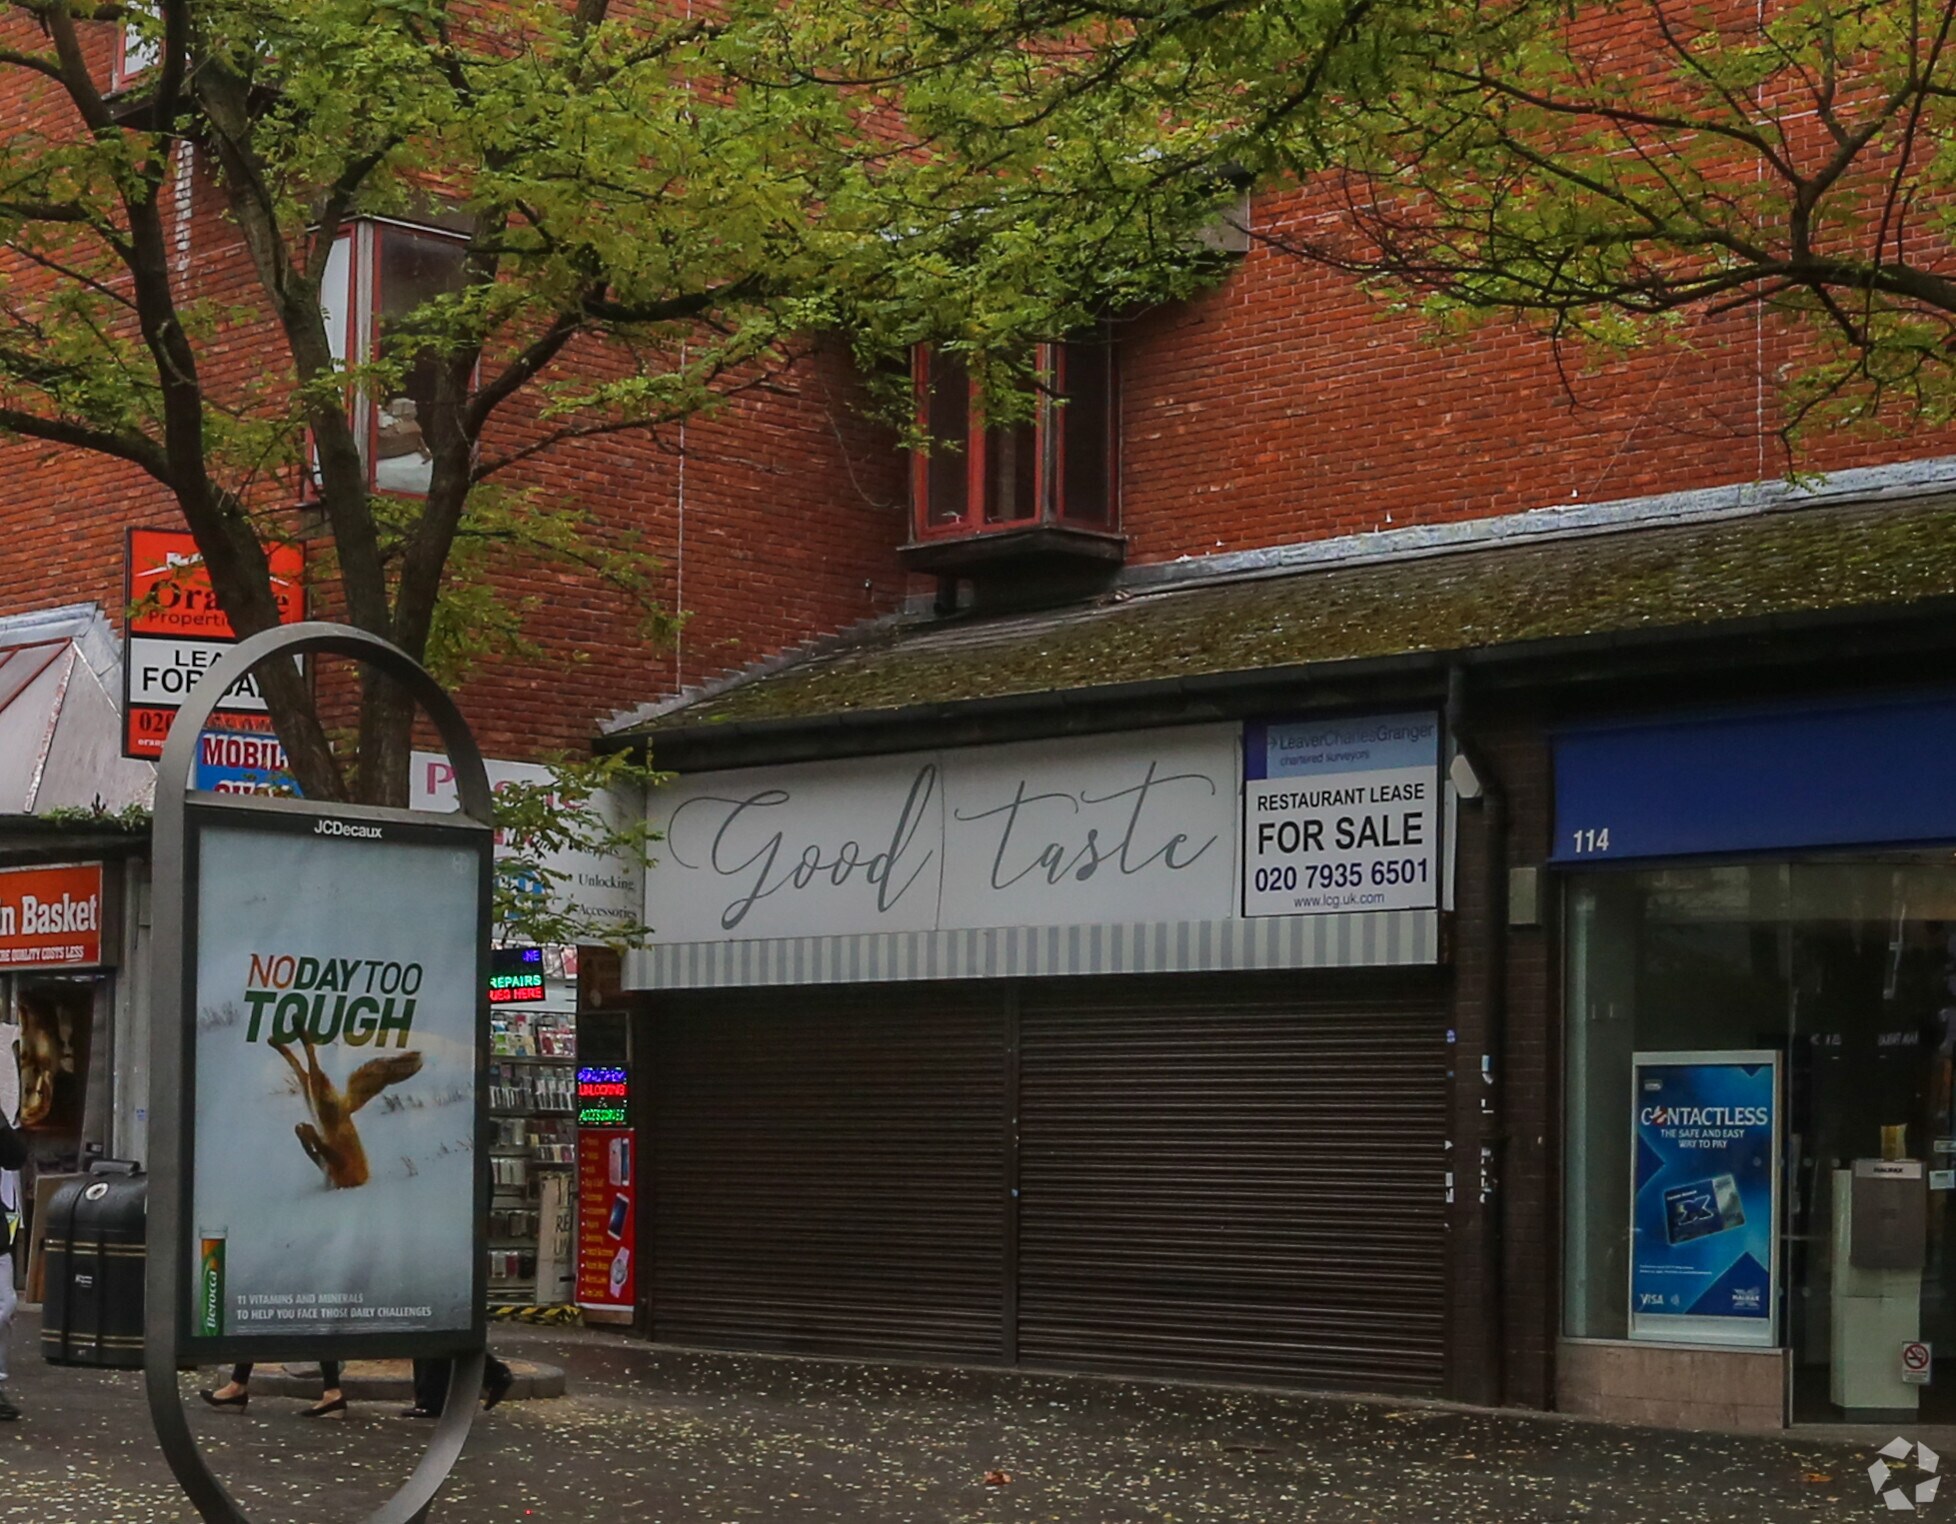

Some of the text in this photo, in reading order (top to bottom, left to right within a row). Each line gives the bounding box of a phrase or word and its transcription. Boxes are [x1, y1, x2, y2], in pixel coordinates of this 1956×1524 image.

[149, 580, 290, 616] Orae
[1280, 752, 1324, 766] chartered
[1258, 783, 1425, 811] RESTAURANT LEASE
[314, 820, 382, 838] JCDecaux
[1258, 812, 1423, 855] FOR SALE
[668, 760, 1219, 930] Good taste
[1573, 828, 1610, 853] 114
[578, 873, 636, 890] Unlocking
[1255, 858, 1427, 892] 020 7935 6501
[1293, 893, 1385, 909] www.lcg.uk.com
[21, 893, 97, 934] Basket
[65, 945, 84, 959] LESS
[247, 953, 423, 996] NO DAY TOO
[243, 990, 416, 1048] TOUGH
[1661, 1129, 1745, 1138] THE SAFE AND EASY
[1679, 1140, 1728, 1149] WAY TO PAY
[207, 1271, 218, 1328] Berocca
[237, 1292, 364, 1304] 11 VITAMINS AND MINERALS
[1640, 1294, 1664, 1305] VISA
[237, 1306, 432, 1320] TO HELP YOU FACE THOSE DAILY CHALLENGES
